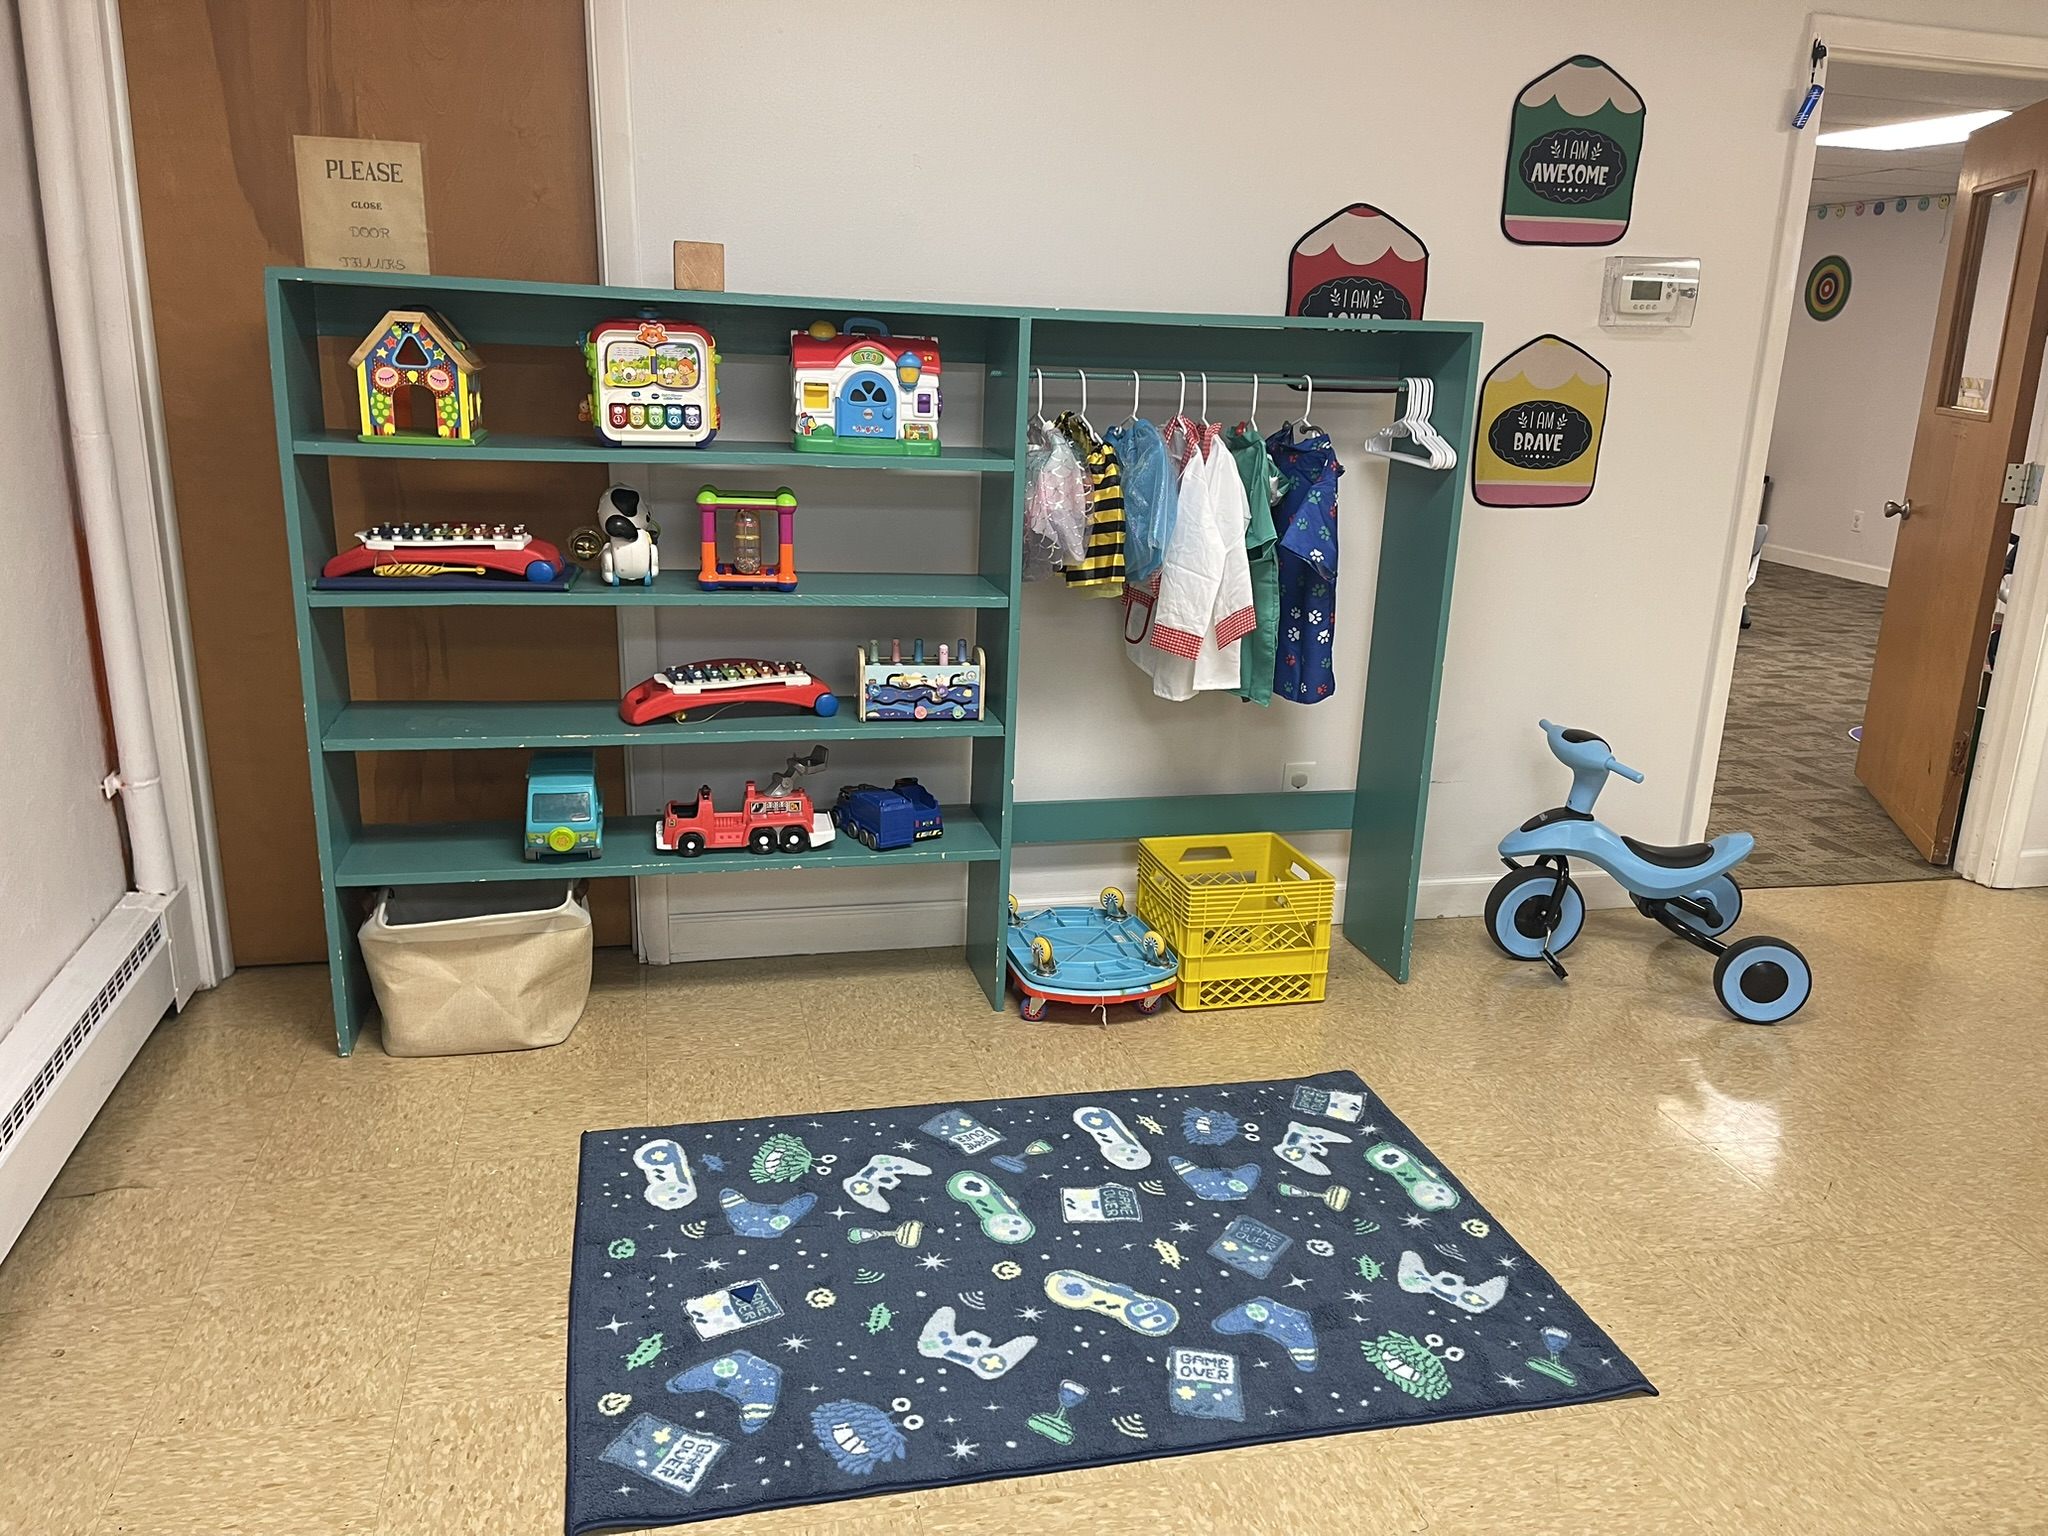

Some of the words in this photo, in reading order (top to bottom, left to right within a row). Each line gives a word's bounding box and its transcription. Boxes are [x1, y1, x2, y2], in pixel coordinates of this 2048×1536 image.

[1562, 138, 1568, 159] I
[1569, 139, 1590, 161] AM
[325, 159, 404, 183] PLEASE
[1530, 162, 1610, 186] AWESOME
[351, 201, 383, 211] CLOSE
[350, 226, 390, 239] DOOR
[1342, 288, 1348, 308] I
[1350, 289, 1371, 309] AM
[1529, 410, 1535, 429] I
[1536, 411, 1556, 430] AM
[1513, 432, 1564, 452] BRAVE
[1180, 1353, 1229, 1370] GAME
[1180, 1366, 1229, 1381] OVER
